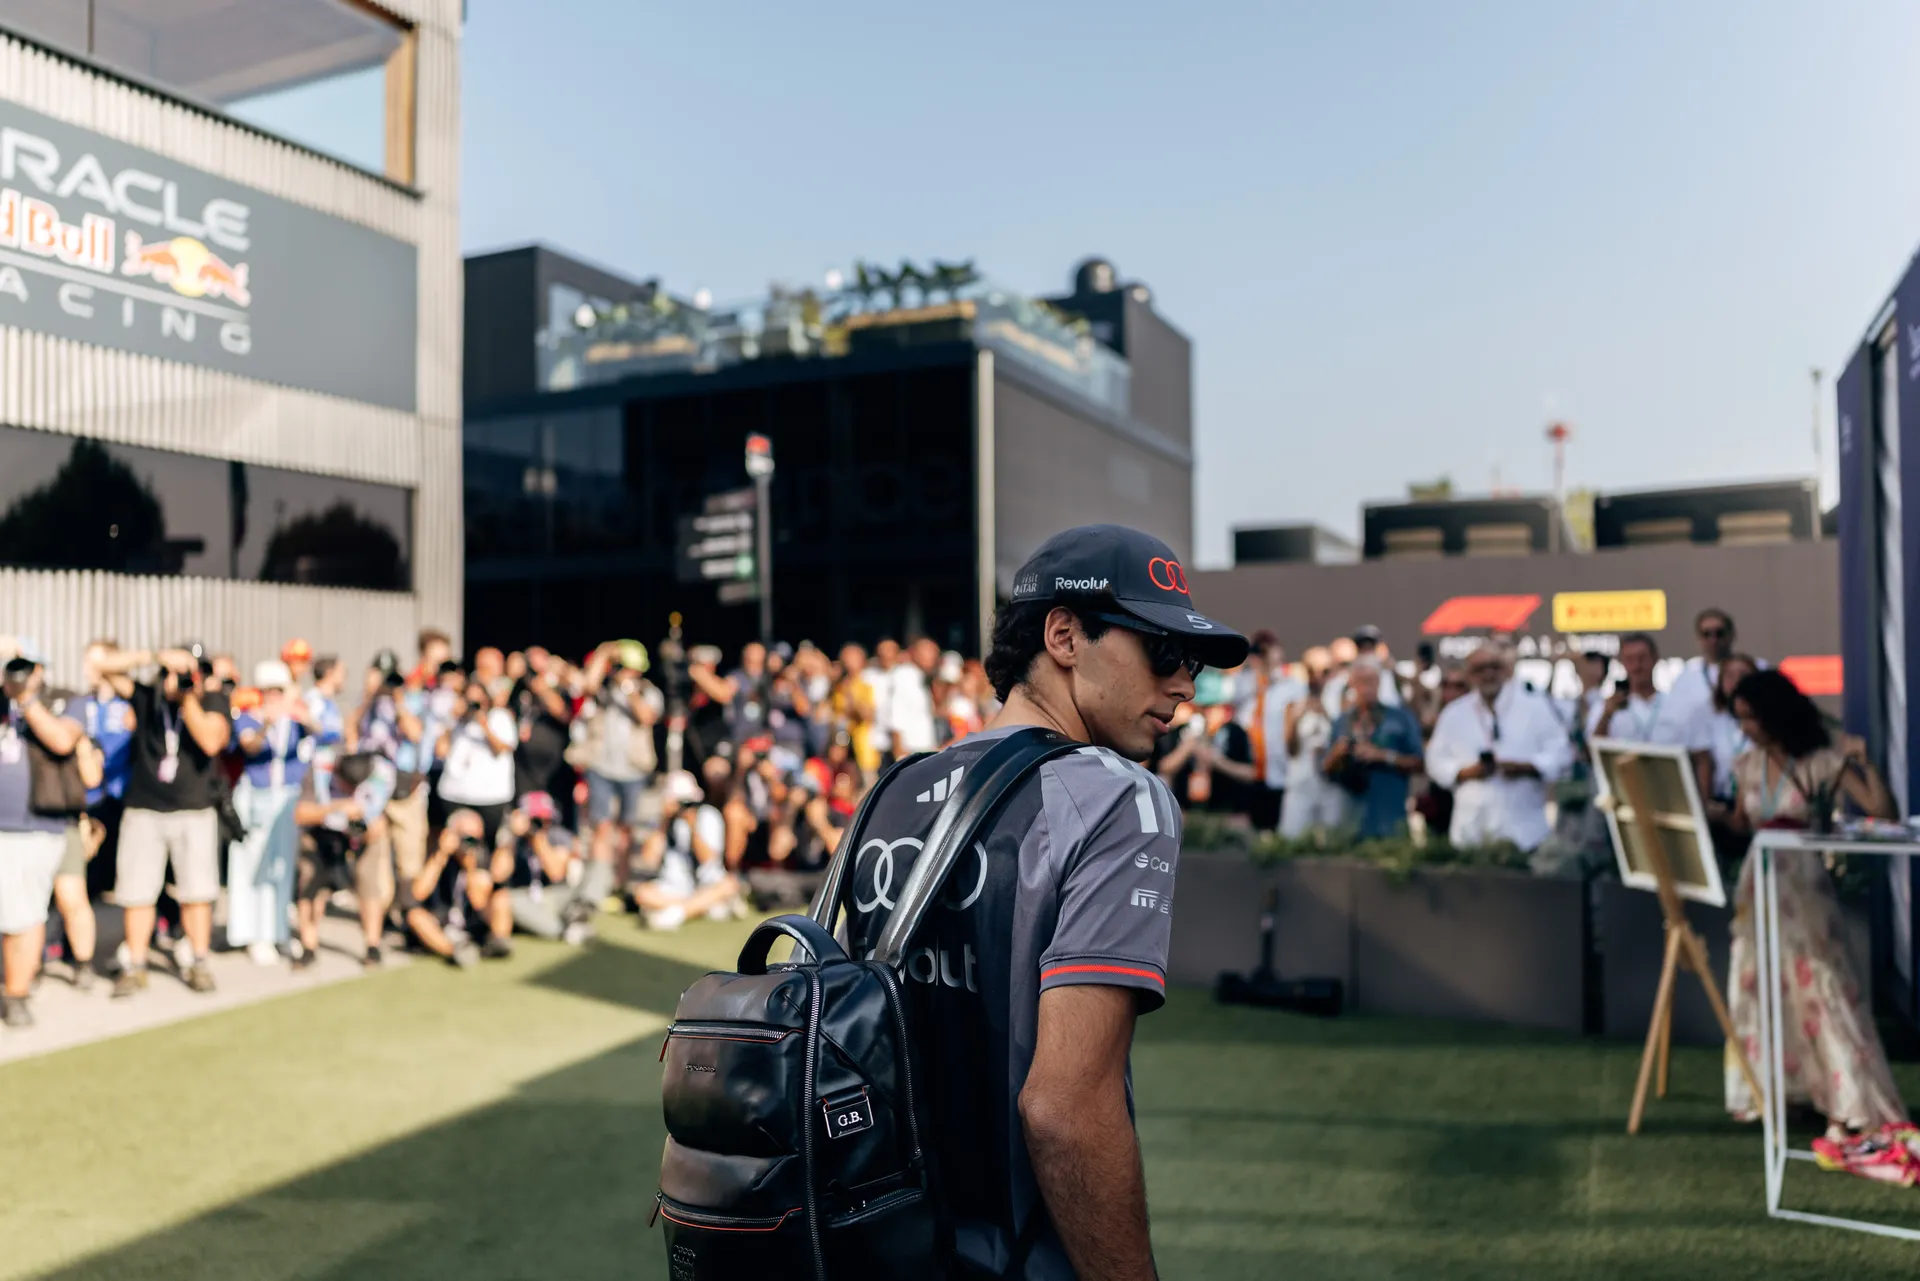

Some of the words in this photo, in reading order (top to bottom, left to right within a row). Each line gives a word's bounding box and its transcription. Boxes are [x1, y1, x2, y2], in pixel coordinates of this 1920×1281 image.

[1055, 576, 1109, 590] Revolut
[1186, 614, 1213, 630] 5
[837, 1111, 863, 1127] G.B.
